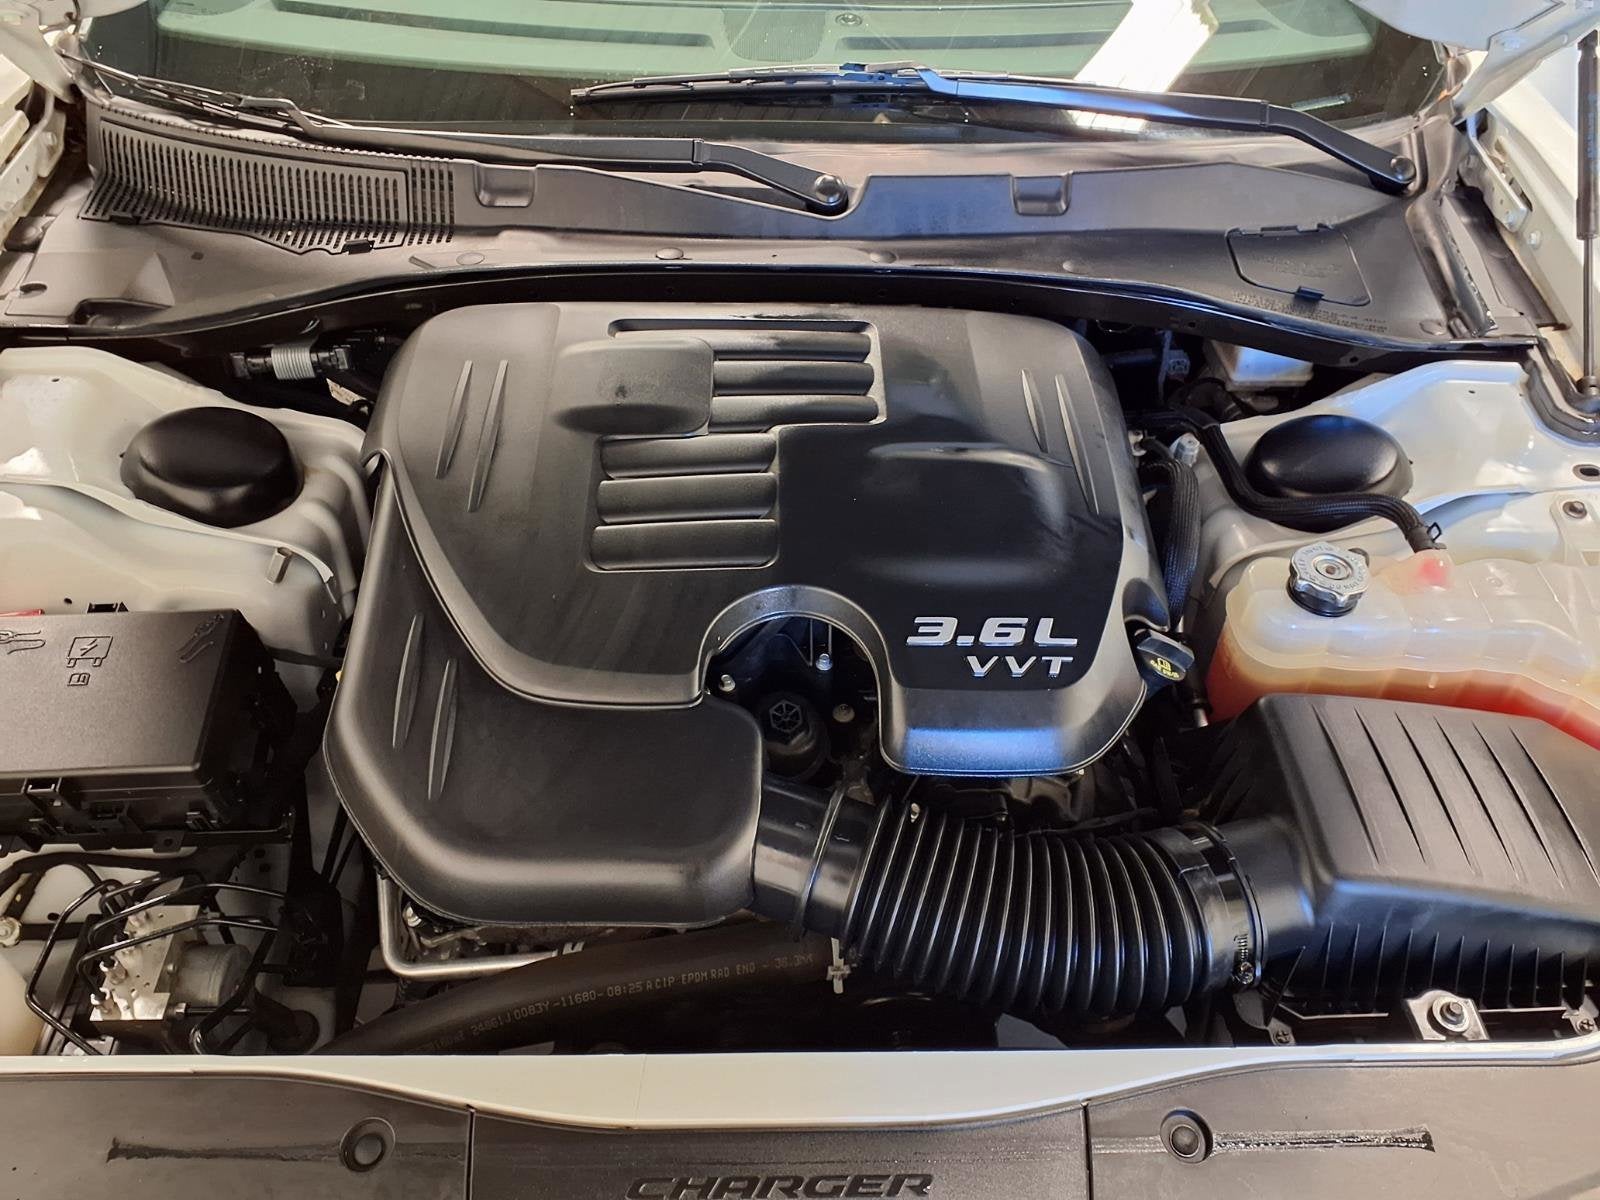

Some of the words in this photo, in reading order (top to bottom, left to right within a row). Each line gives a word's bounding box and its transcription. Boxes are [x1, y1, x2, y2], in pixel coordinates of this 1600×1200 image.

[906, 616, 1078, 647] 3.6L
[966, 656, 1074, 678] VVT
[625, 1173, 934, 1200] CHARGER
